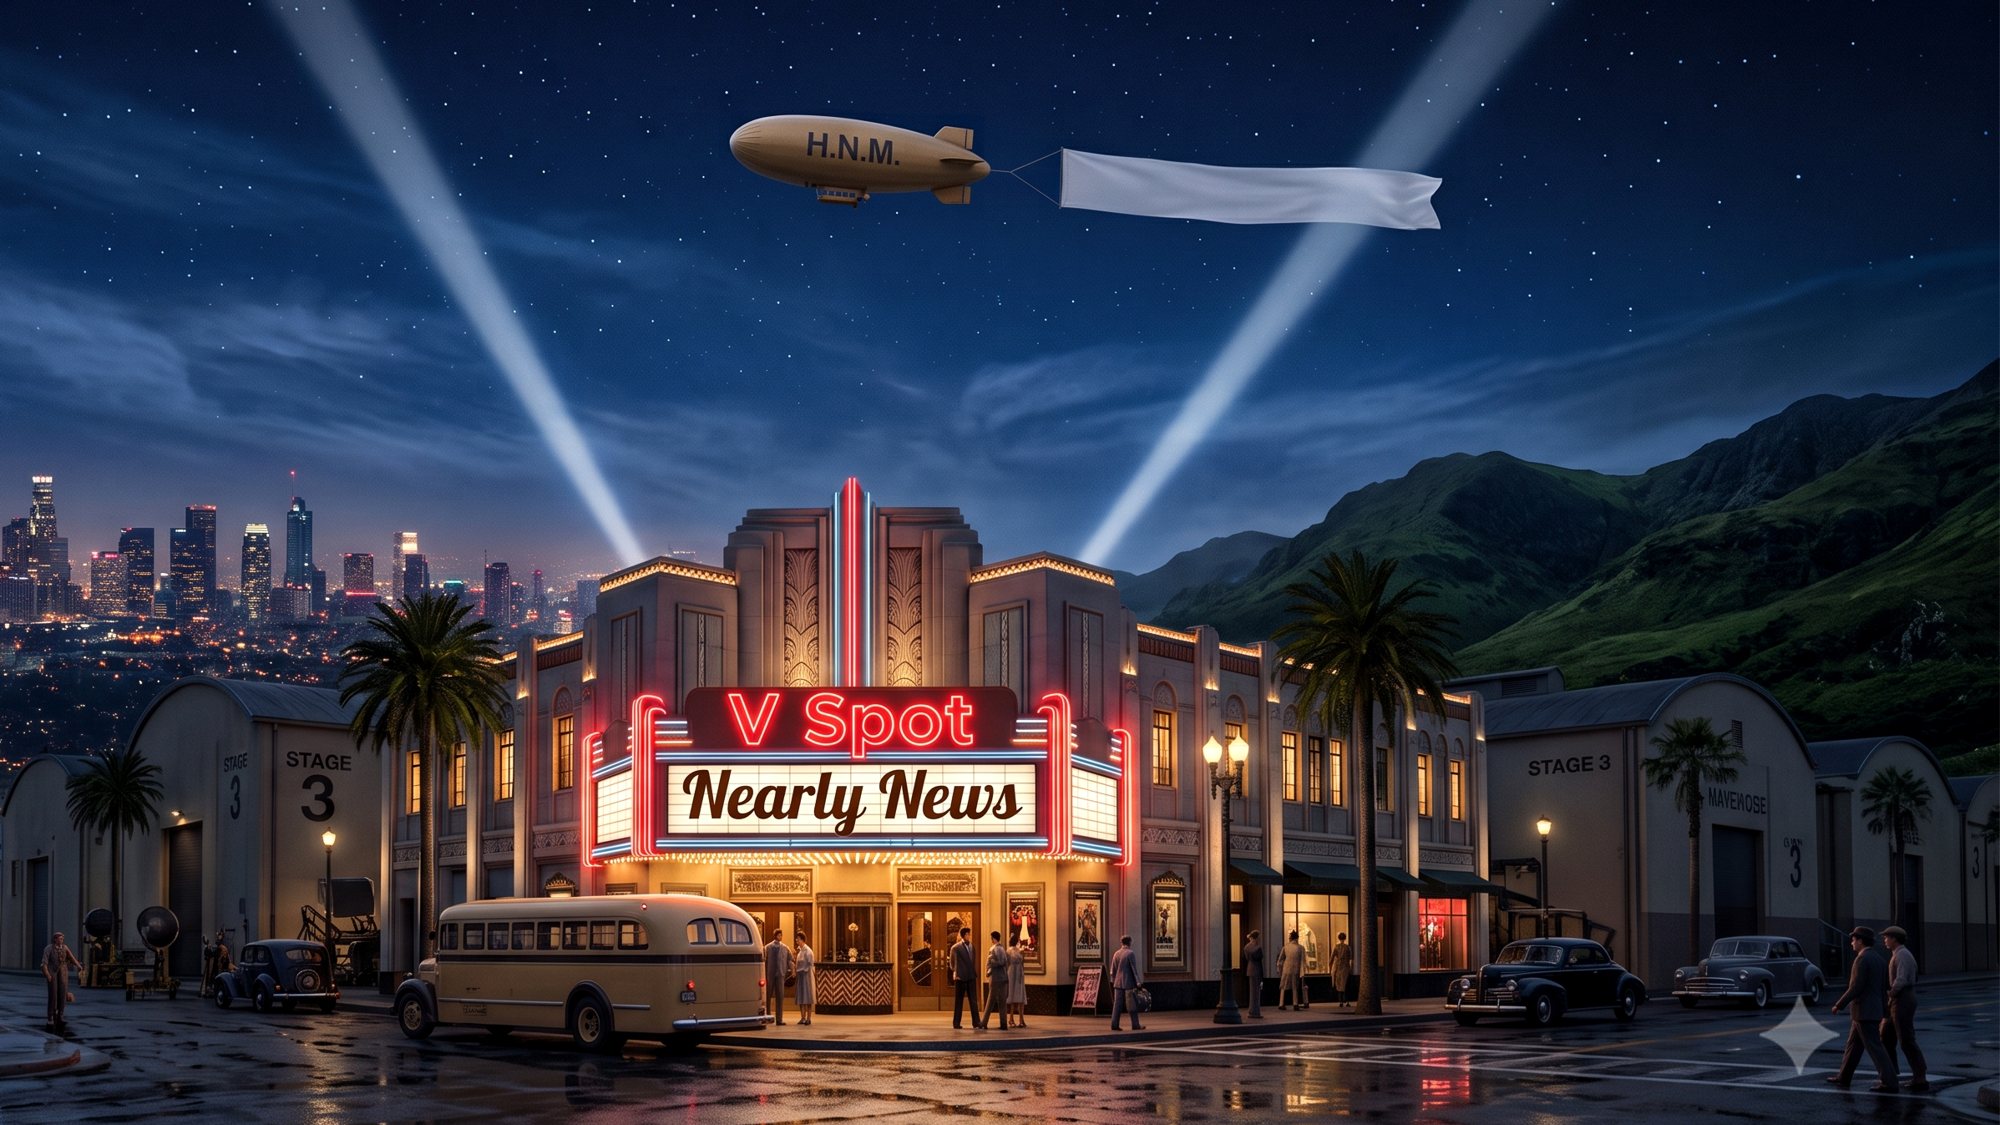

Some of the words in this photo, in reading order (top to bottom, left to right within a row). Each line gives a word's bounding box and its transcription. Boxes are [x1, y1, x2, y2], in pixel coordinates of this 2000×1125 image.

[807, 132, 900, 166] H.N.M.
[727, 693, 780, 746] V
[804, 692, 974, 759] Spot
[223, 752, 248, 773] STAGE
[286, 751, 352, 772] STAGE
[1528, 756, 1594, 776] STAGE
[1599, 754, 1611, 771] 3
[229, 775, 241, 820] 3
[301, 774, 335, 822] 3
[682, 769, 867, 837] Nearly
[878, 769, 1024, 821] News
[1790, 844, 1802, 888] 3
